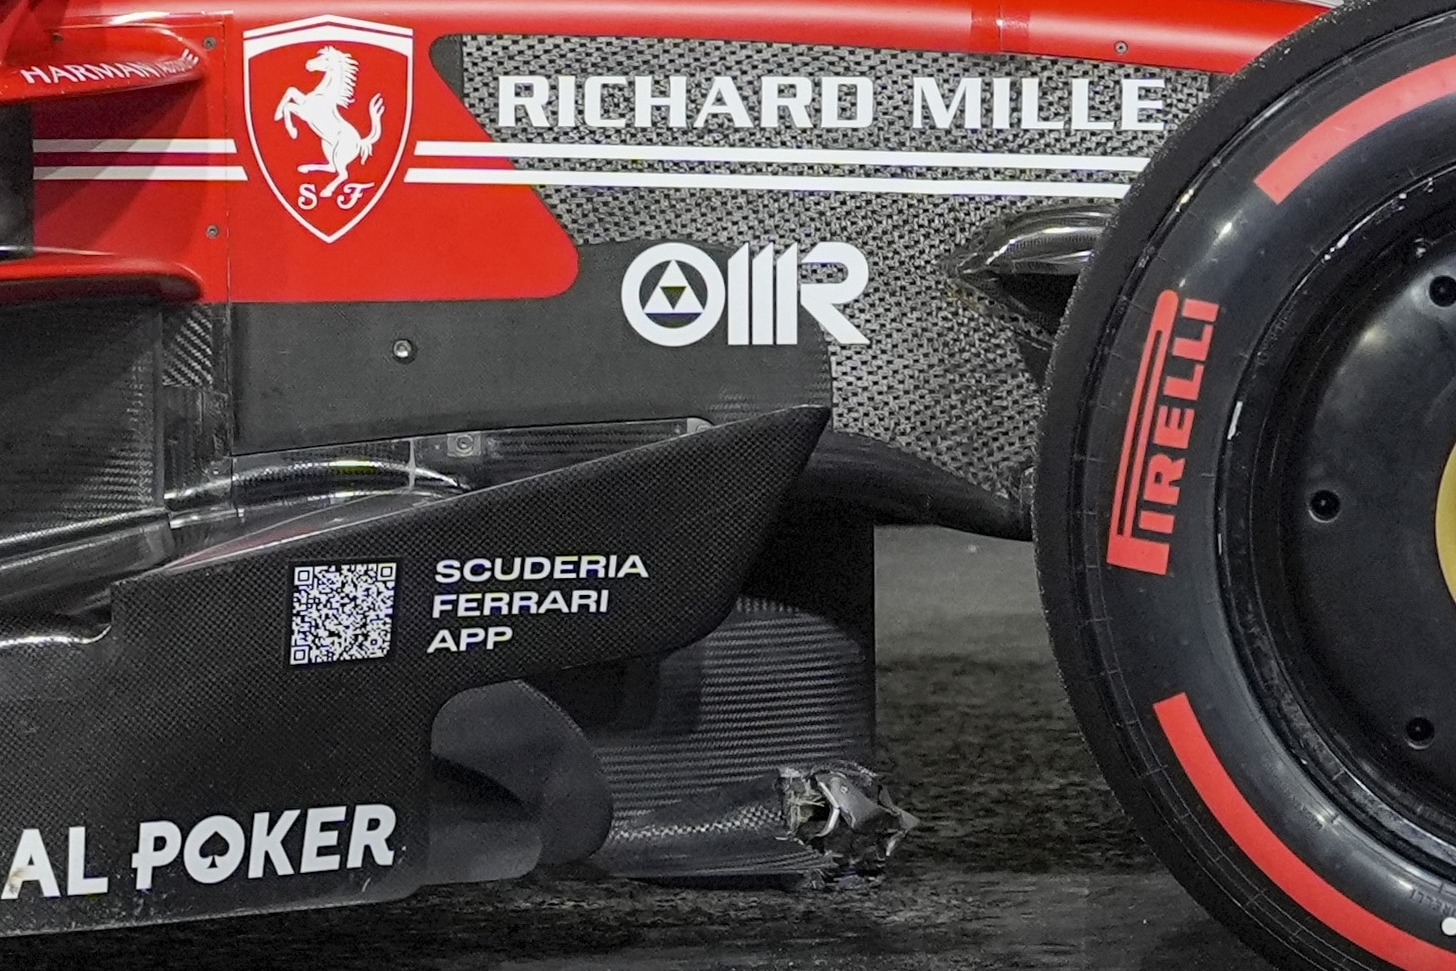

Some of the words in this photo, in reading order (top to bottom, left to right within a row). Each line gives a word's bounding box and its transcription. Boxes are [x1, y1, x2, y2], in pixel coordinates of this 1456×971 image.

[19, 60, 161, 84] HARMAN
[497, 75, 874, 129] RICHARD
[911, 76, 1167, 131] MILLE
[1106, 288, 1220, 576] PIRELLI
[433, 554, 650, 584] SCUDERIA
[431, 589, 610, 619] FERRARI
[426, 626, 514, 654] APP
[130, 803, 398, 891] POKER
